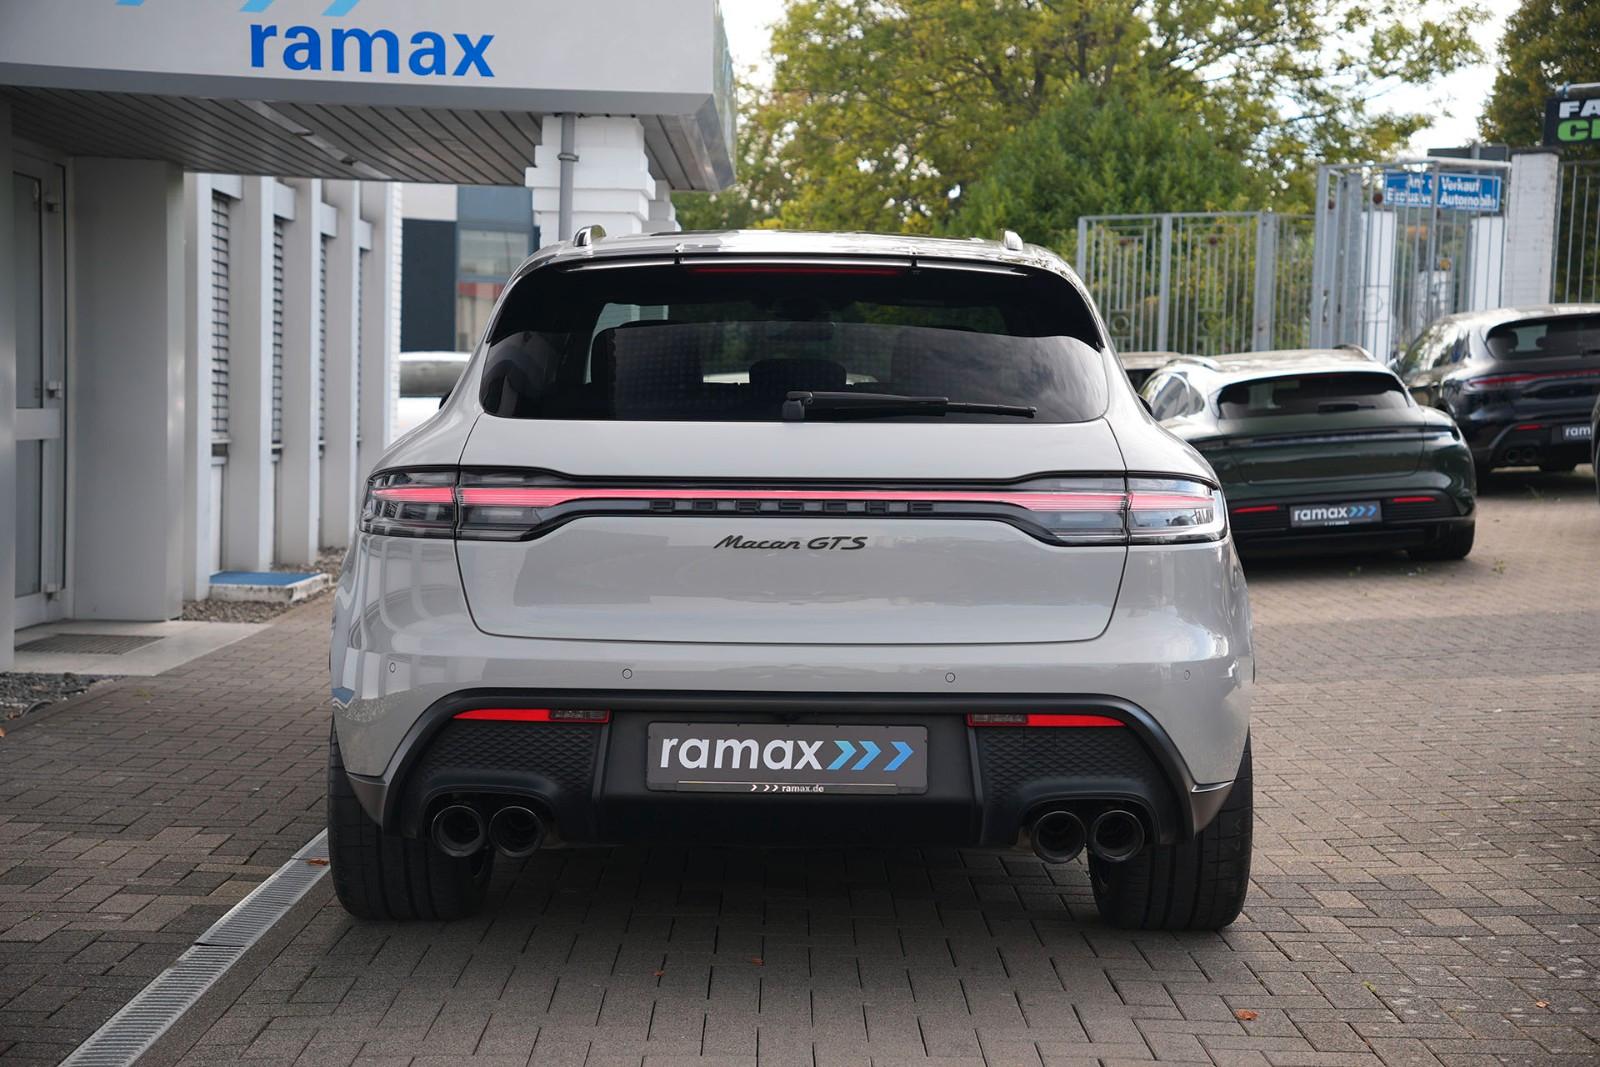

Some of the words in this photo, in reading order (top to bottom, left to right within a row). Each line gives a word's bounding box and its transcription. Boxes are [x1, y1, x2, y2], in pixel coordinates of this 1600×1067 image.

[250, 24, 495, 77] ramax
[1441, 176, 1480, 192] Verkauf
[1294, 507, 1348, 521] ramax
[713, 534, 800, 550] Macan
[807, 536, 868, 550] GTS
[659, 737, 824, 770] ramax
[782, 784, 825, 793] ramax.de
